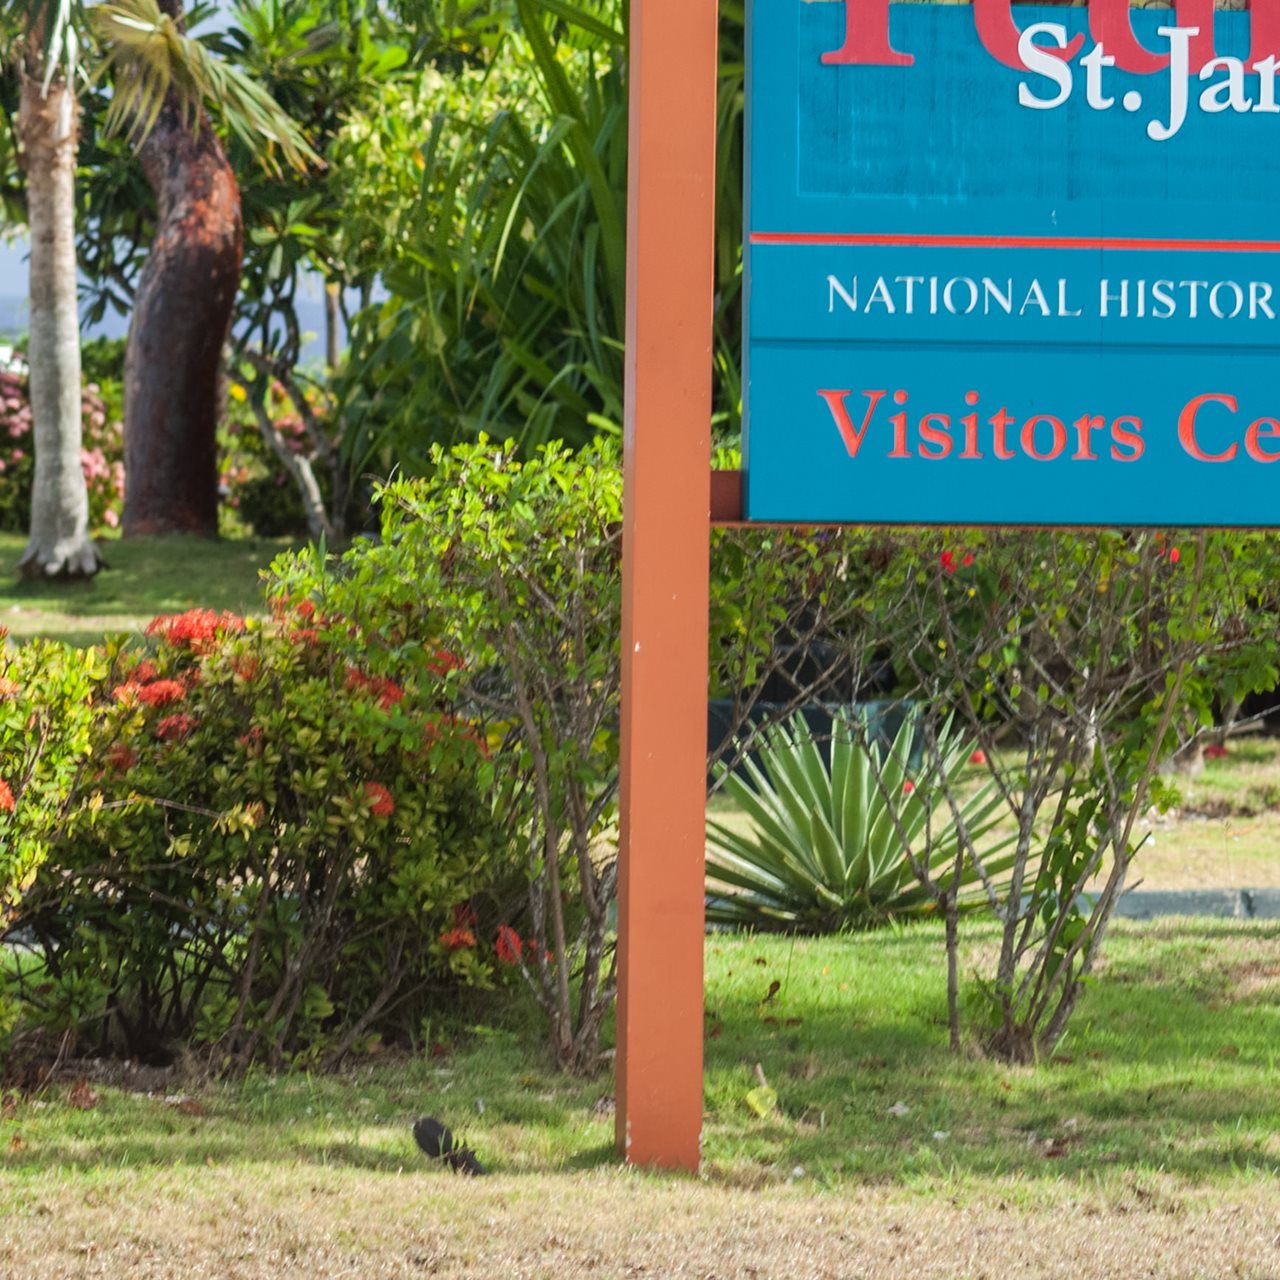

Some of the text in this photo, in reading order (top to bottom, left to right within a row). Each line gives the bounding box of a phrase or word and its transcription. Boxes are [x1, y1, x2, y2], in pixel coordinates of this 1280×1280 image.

[1017, 22, 1141, 112] St.
[827, 275, 1082, 318] NATIONAL
[817, 389, 1146, 463] Visitors
